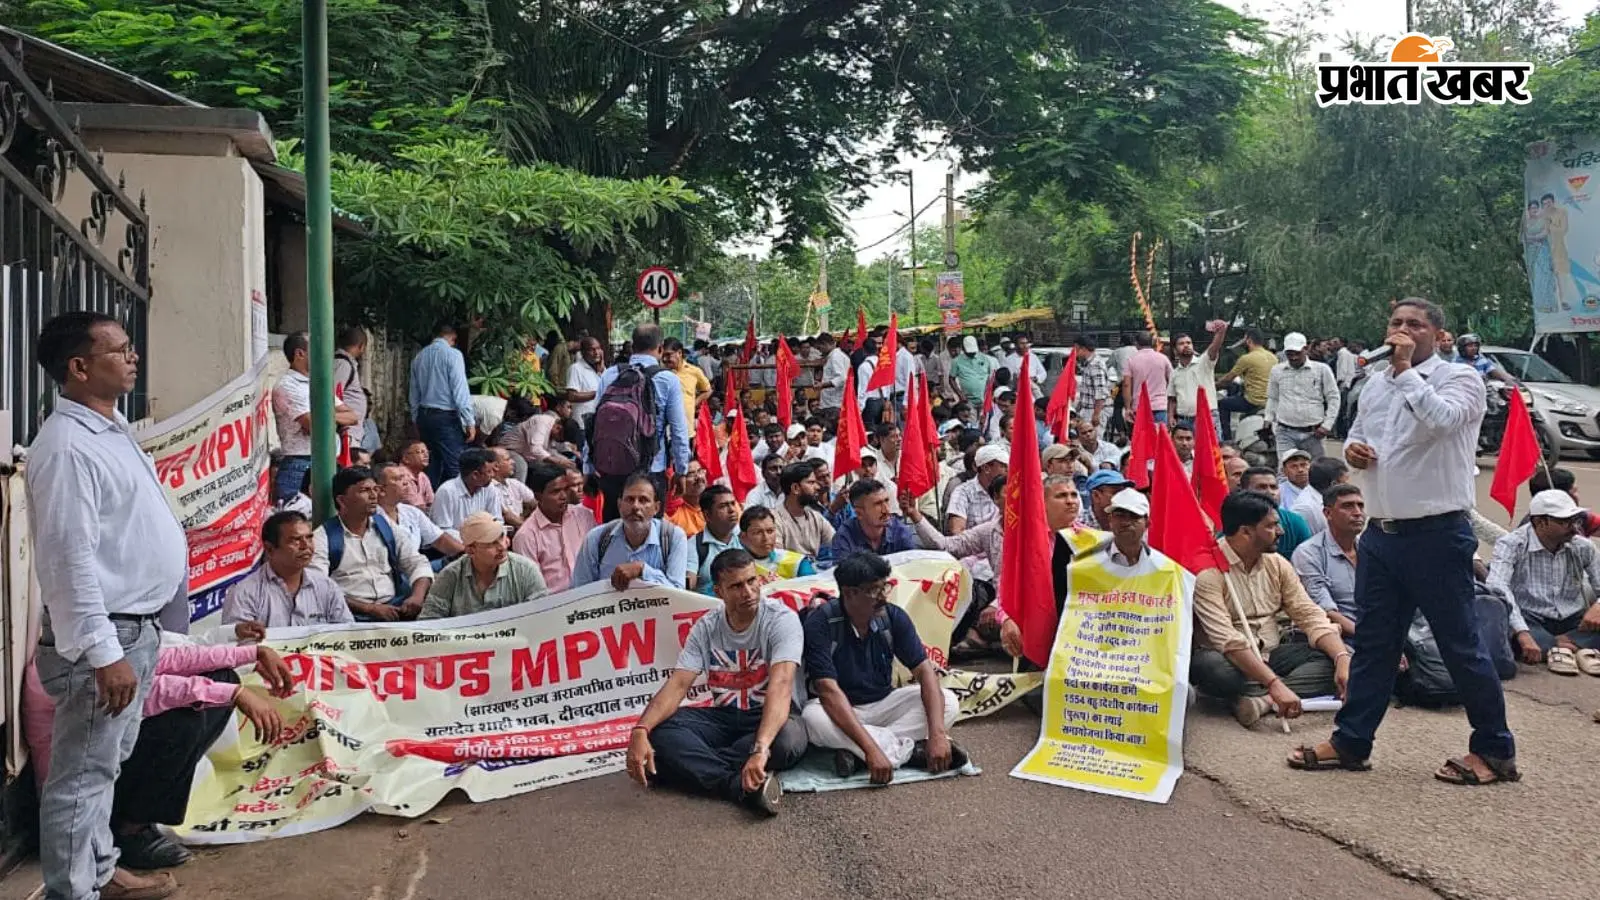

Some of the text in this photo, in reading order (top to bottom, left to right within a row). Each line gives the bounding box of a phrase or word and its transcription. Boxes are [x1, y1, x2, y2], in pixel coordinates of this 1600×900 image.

[643, 273, 671, 300] 40
[566, 604, 615, 624] इंकलाब
[390, 636, 408, 646] 663
[511, 617, 657, 692] MPW
[464, 698, 519, 718] (झारखण्ड
[522, 693, 548, 708] राज्य
[551, 681, 613, 702] अराजपत्रित
[615, 667, 660, 688] कर्मचारी
[1064, 694, 1085, 705] 1554
[559, 698, 621, 722] दीनदयाल
[1091, 711, 1102, 721] का
[1105, 728, 1125, 743] किया
